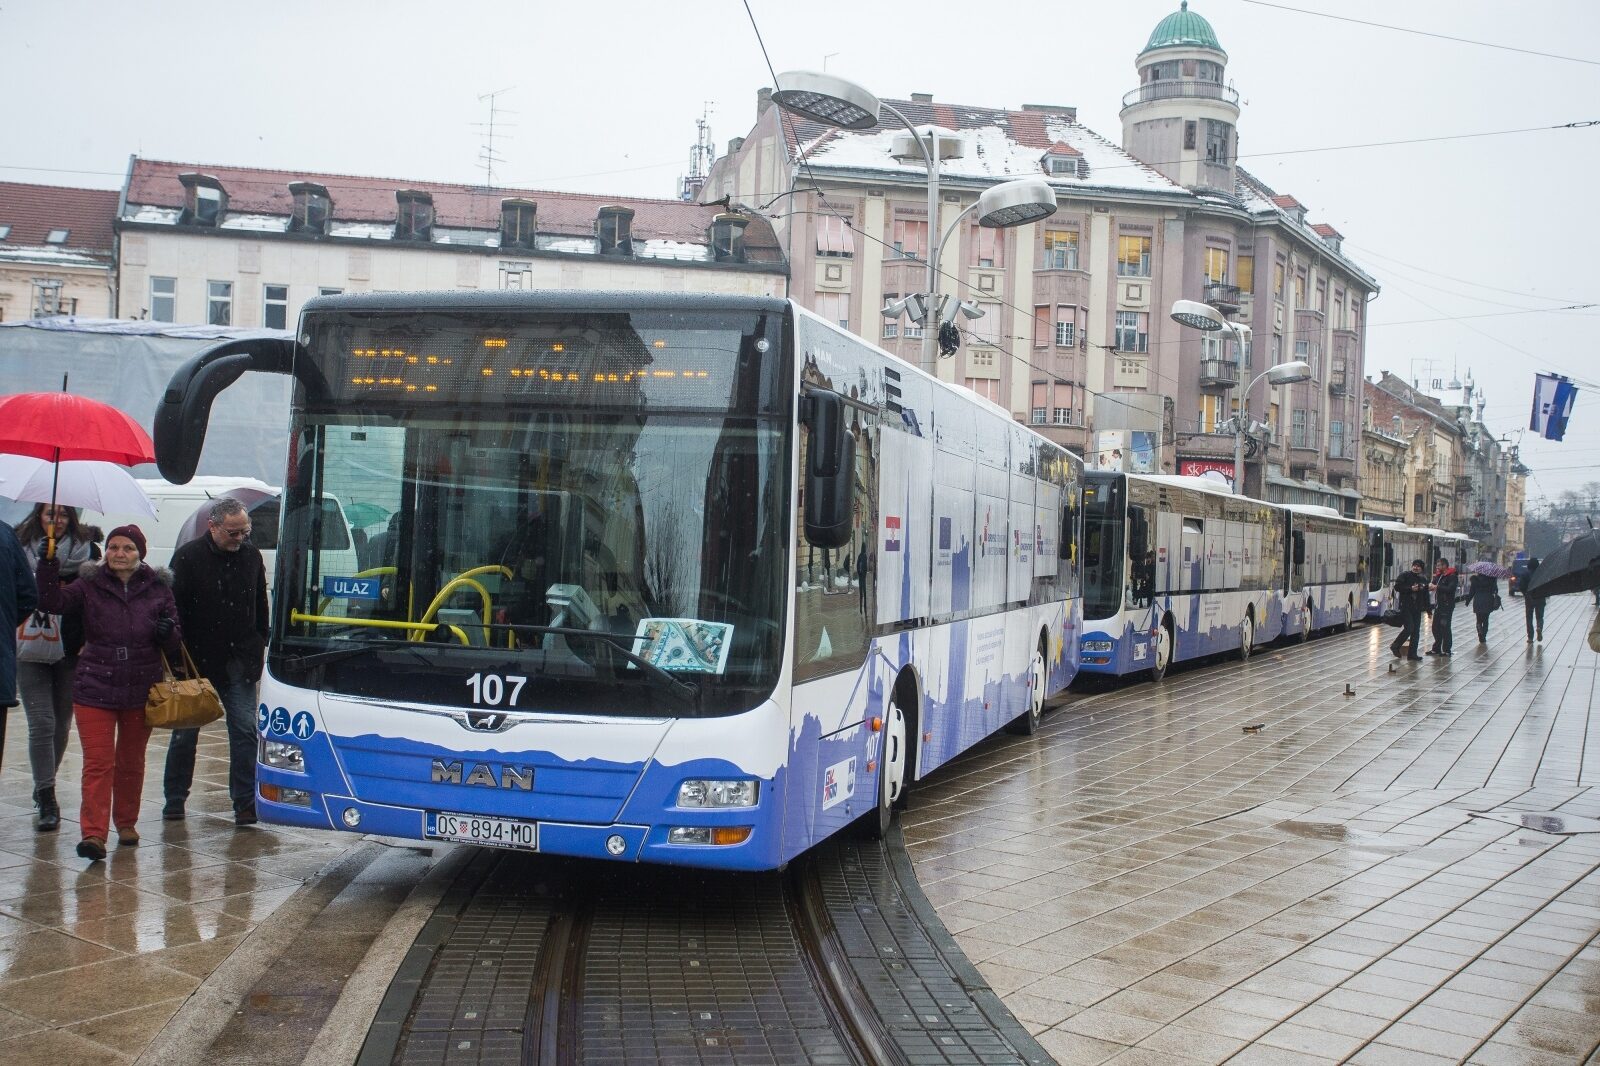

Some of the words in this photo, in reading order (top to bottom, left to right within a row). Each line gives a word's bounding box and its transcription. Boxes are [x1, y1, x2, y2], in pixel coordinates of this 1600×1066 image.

[334, 581, 369, 595] ULAZ
[466, 672, 527, 706] 107
[866, 732, 880, 762] 107
[431, 758, 535, 792] MAN
[427, 825, 436, 833] HR
[438, 815, 457, 835] OS
[471, 820, 532, 843] 894-MO
